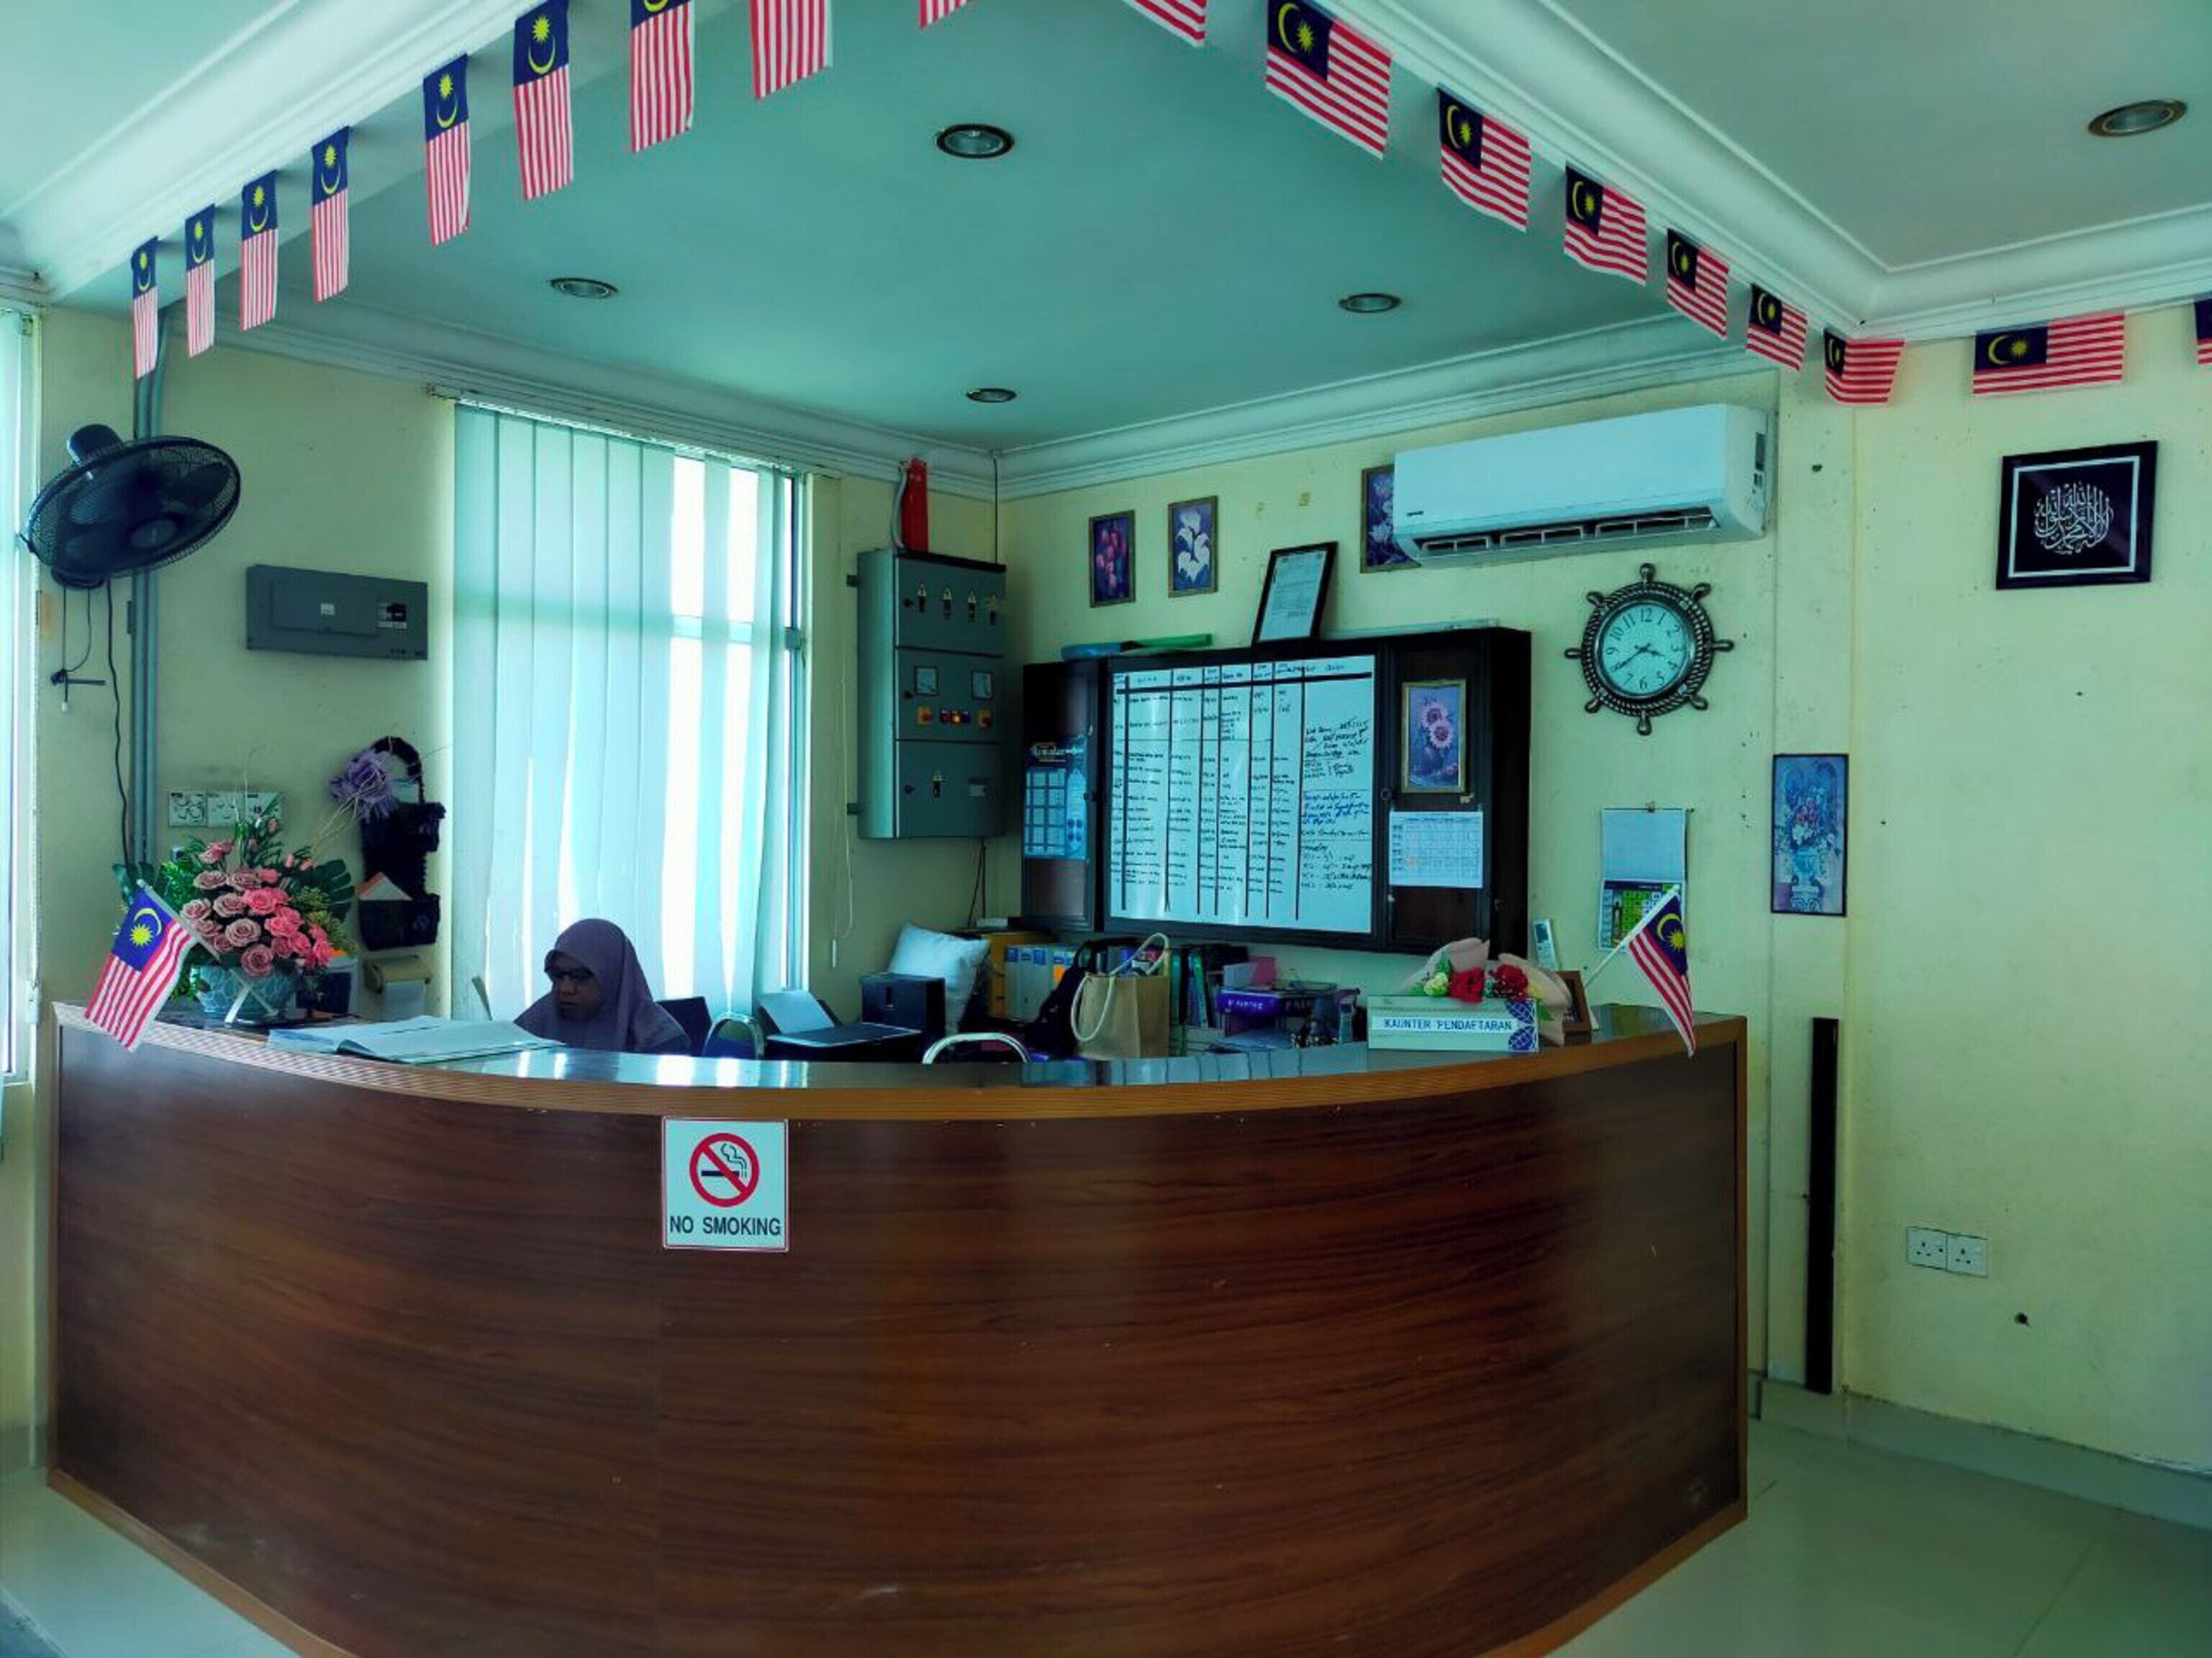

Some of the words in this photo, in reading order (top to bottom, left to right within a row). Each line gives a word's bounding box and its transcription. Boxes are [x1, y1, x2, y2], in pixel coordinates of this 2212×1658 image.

[1622, 612, 1636, 629] 11
[1641, 607, 1653, 622] 12
[1657, 611, 1667, 625] 1
[1610, 626, 1625, 641] 10
[1667, 624, 1681, 637] 2
[1667, 661, 1680, 671] 4
[1622, 672, 1634, 687] 7
[1639, 676, 1648, 689] 6
[1656, 670, 1664, 686] 5
[1384, 1018, 1431, 1030] KAUNTER
[1437, 1019, 1513, 1030] PENDAFTARAN
[670, 1215, 694, 1233] NO
[703, 1216, 781, 1236] SMOKING
